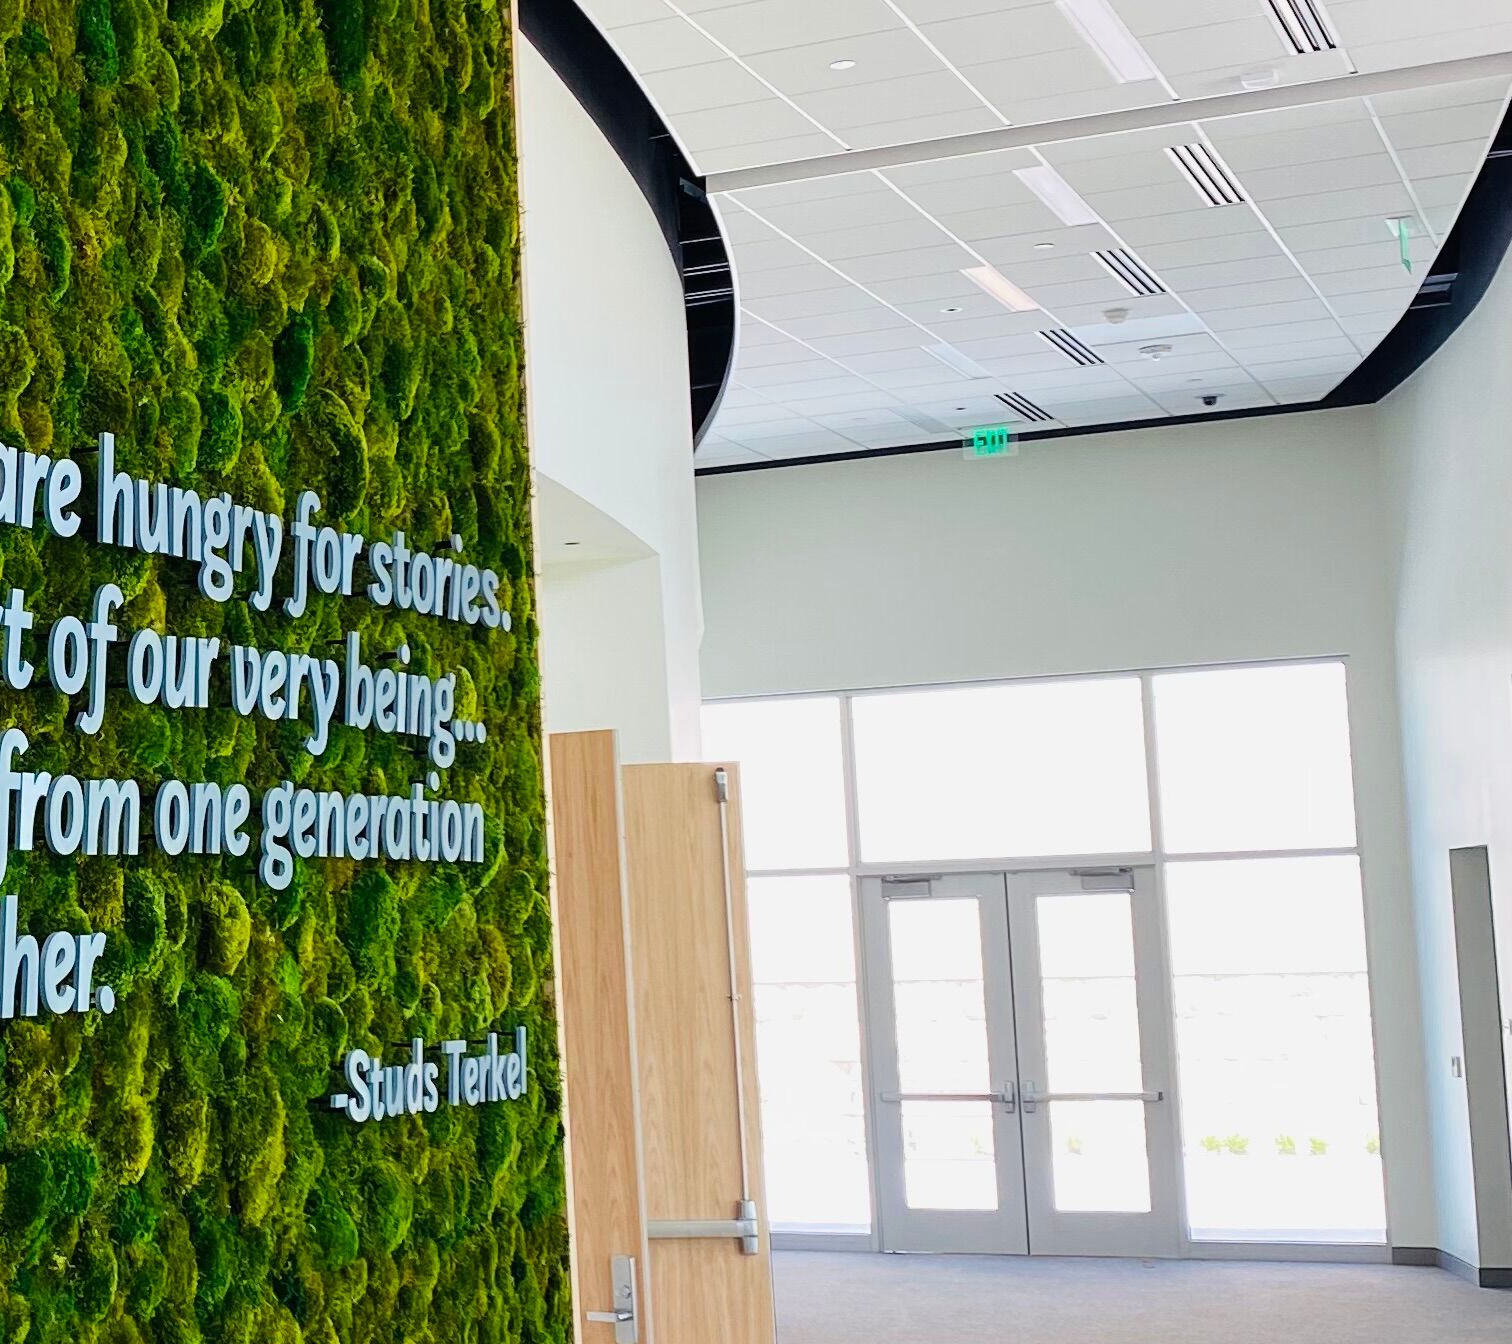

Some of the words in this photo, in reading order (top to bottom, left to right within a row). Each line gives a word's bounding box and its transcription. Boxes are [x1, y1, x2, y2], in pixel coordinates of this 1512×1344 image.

[98, 432, 283, 612] hungry
[283, 490, 364, 618] for
[368, 531, 513, 632] stories.
[48, 583, 124, 735] of
[128, 628, 219, 708] our
[231, 645, 340, 756] very
[345, 631, 487, 769] being...
[155, 779, 251, 857] one
[259, 771, 485, 890] generation
[330, 1037, 439, 1124] -Studs
[441, 1026, 528, 1107] Terkel
